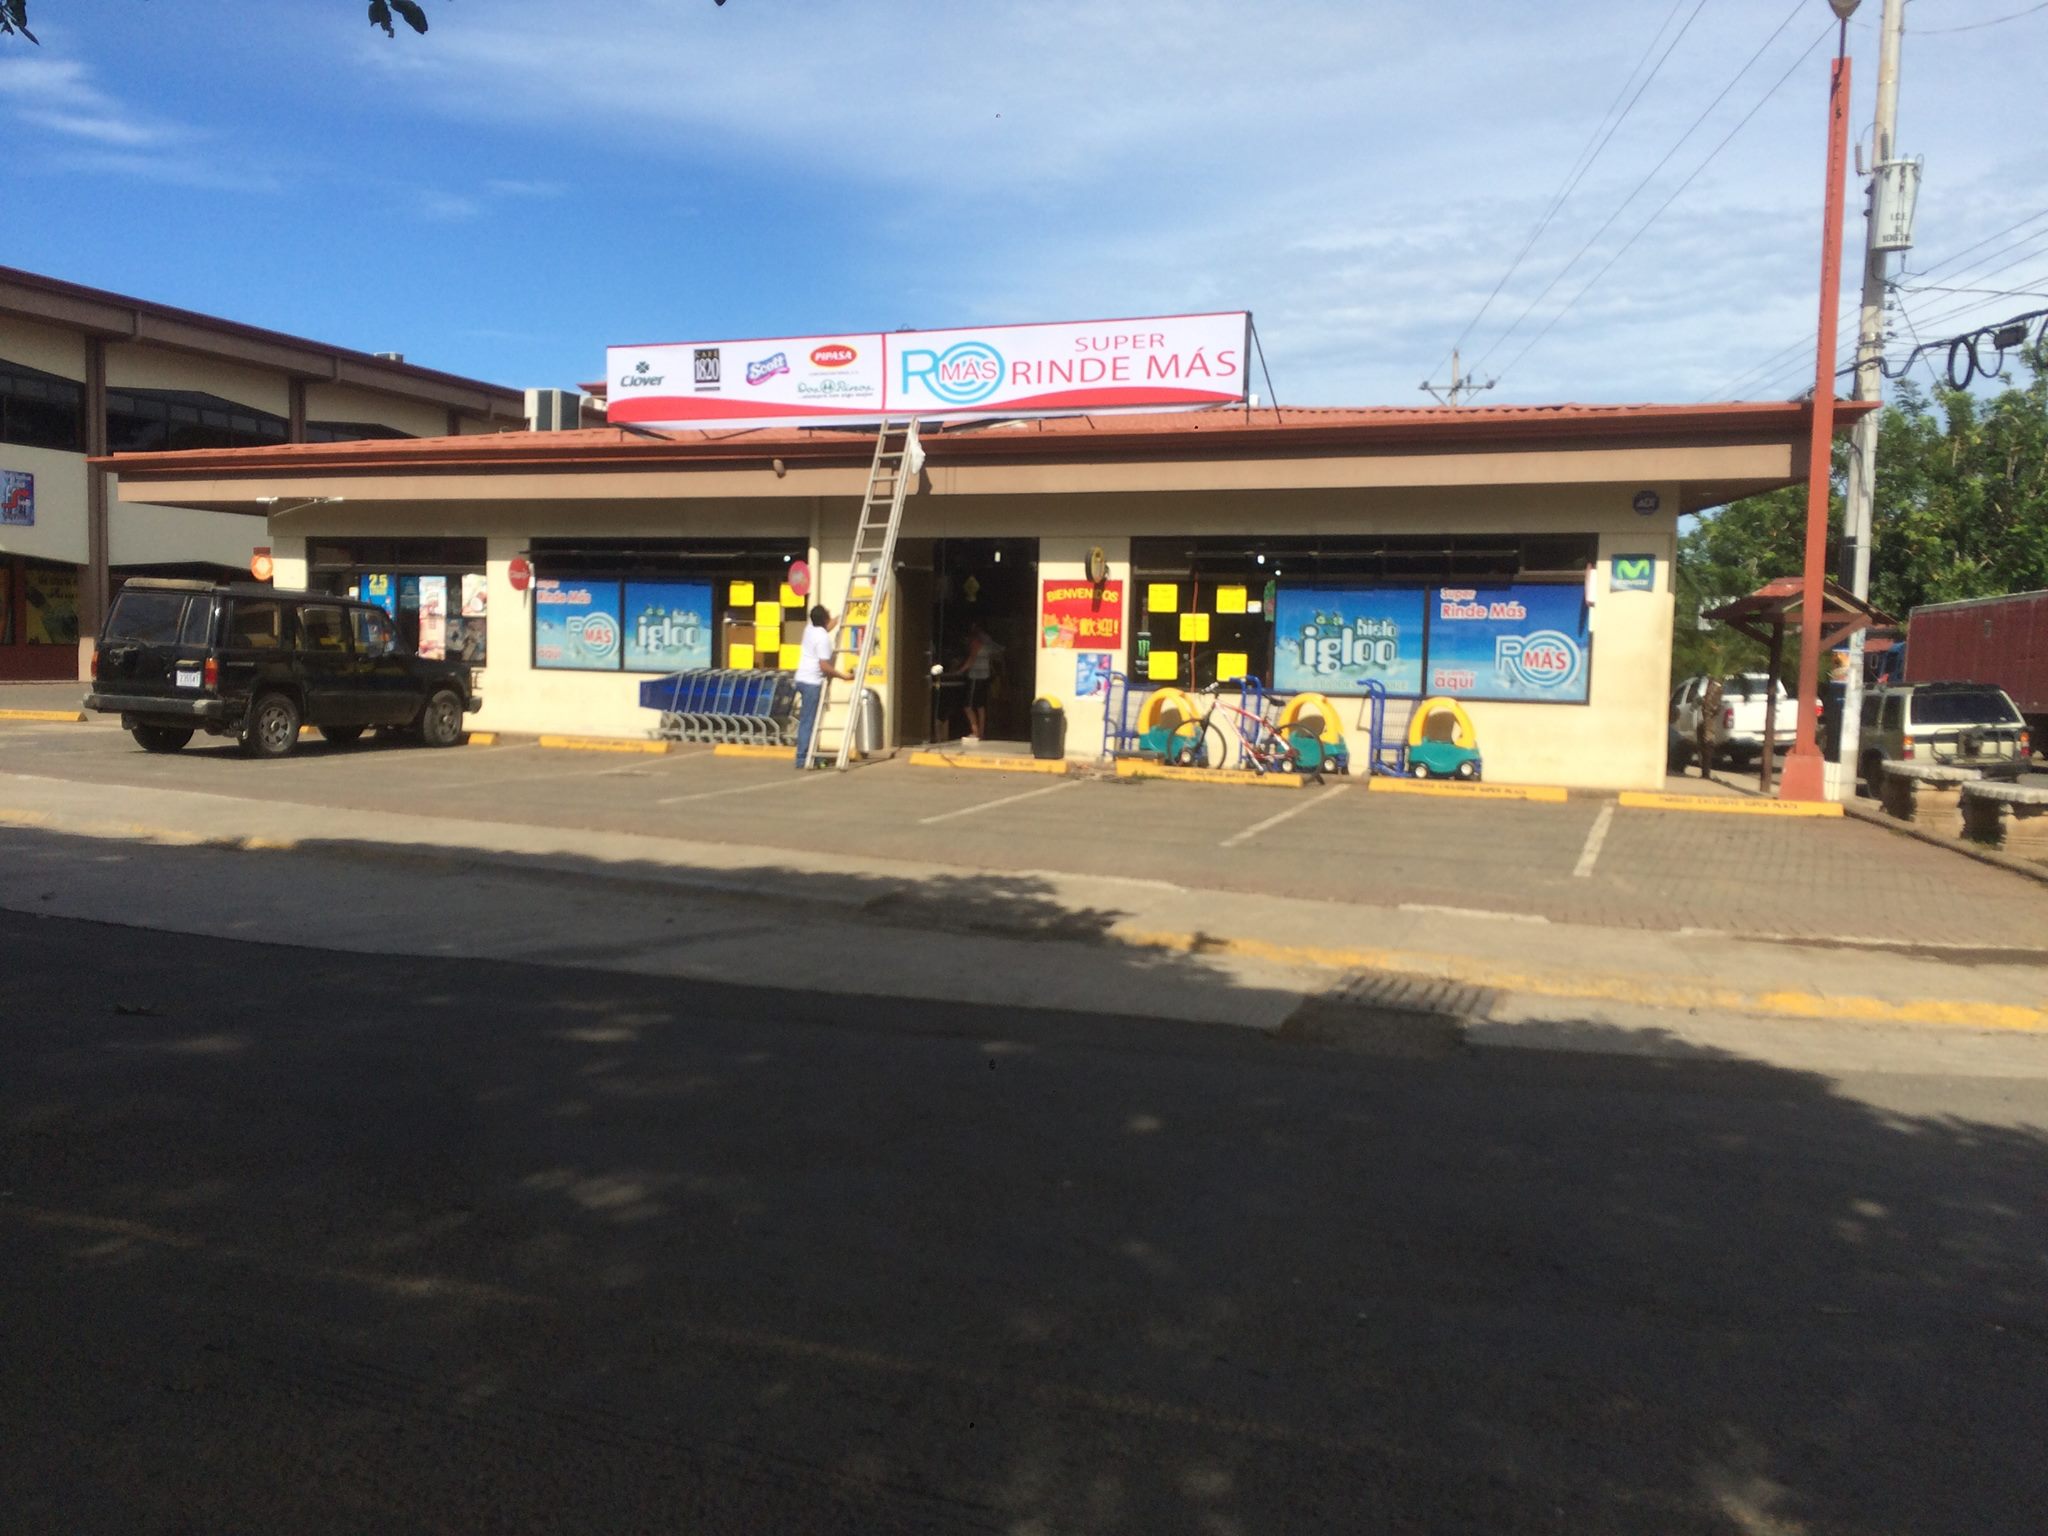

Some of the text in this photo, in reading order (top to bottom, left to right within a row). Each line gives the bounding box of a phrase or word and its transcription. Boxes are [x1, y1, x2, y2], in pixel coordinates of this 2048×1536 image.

[1075, 333, 1165, 352] SUPER
[815, 350, 853, 361] PIPASA
[1012, 346, 1237, 386] RINDE MÁS
[695, 358, 719, 380] 1820
[750, 354, 785, 380] Scott
[941, 357, 997, 381] MÁS
[620, 374, 665, 387] Clover
[1440, 588, 1476, 601] Super
[1441, 601, 1526, 619] Rinde Más
[1303, 626, 1397, 674] igloo
[1524, 648, 1566, 670] MÁS
